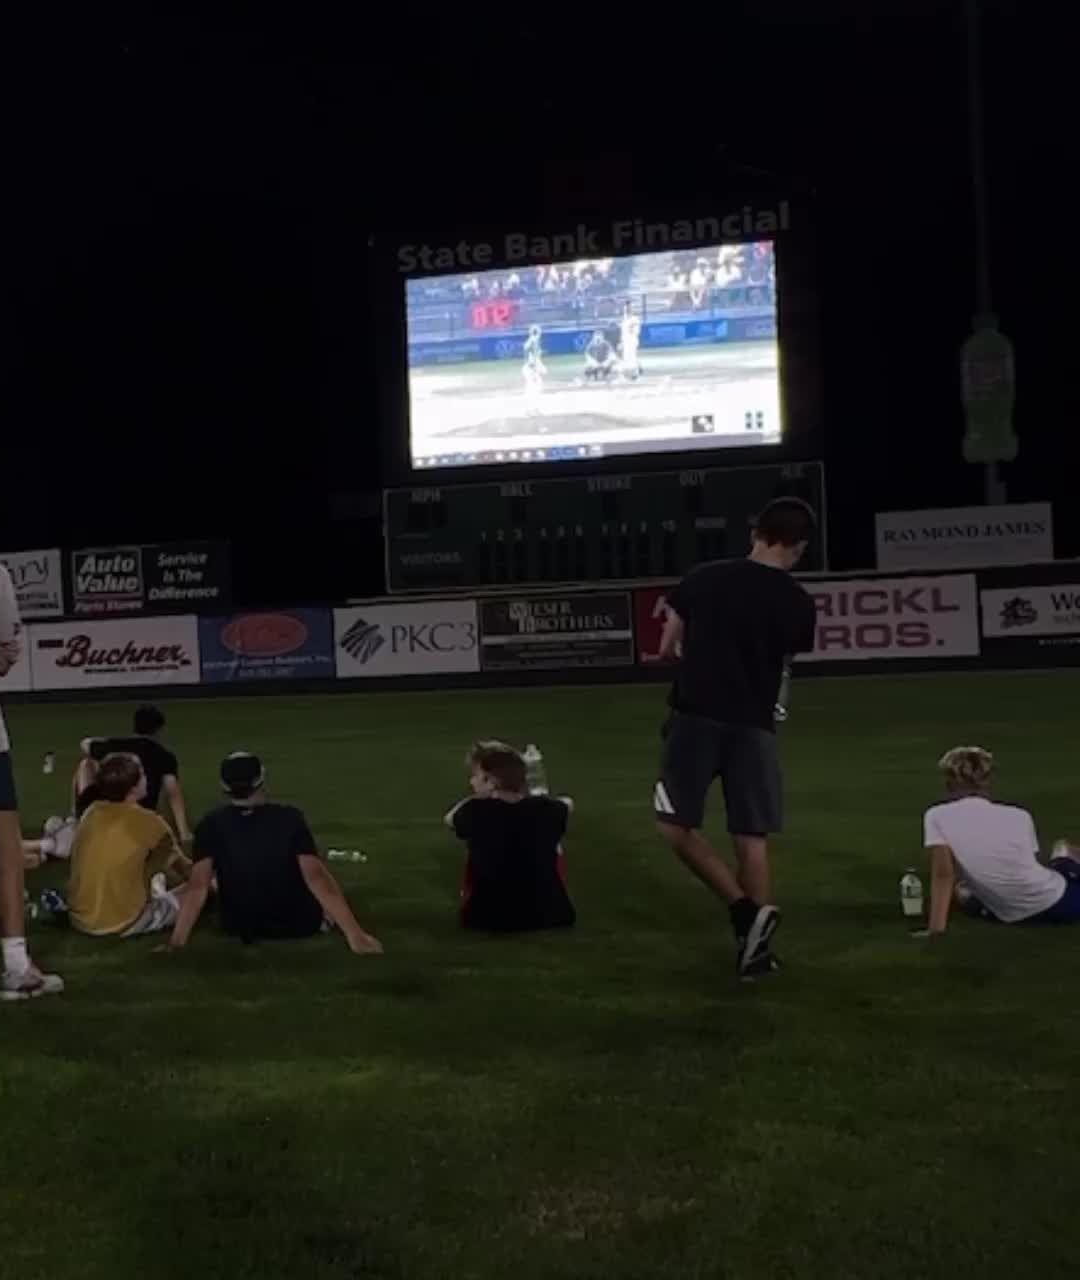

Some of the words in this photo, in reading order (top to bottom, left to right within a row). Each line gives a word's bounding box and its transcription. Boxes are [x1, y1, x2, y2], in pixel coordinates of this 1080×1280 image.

[396, 240, 494, 273] State
[503, 223, 600, 262] Bank
[612, 199, 792, 249] Financial
[883, 524, 980, 544] RAYMOND
[983, 520, 1046, 538] JAMES
[79, 554, 136, 575] Auto
[156, 551, 209, 568] Service
[76, 572, 139, 594] Value
[177, 567, 204, 583] The
[147, 585, 220, 601] Difference
[812, 587, 960, 617] RICKL
[818, 622, 945, 651] ROS.
[56, 634, 183, 668] Buchner
